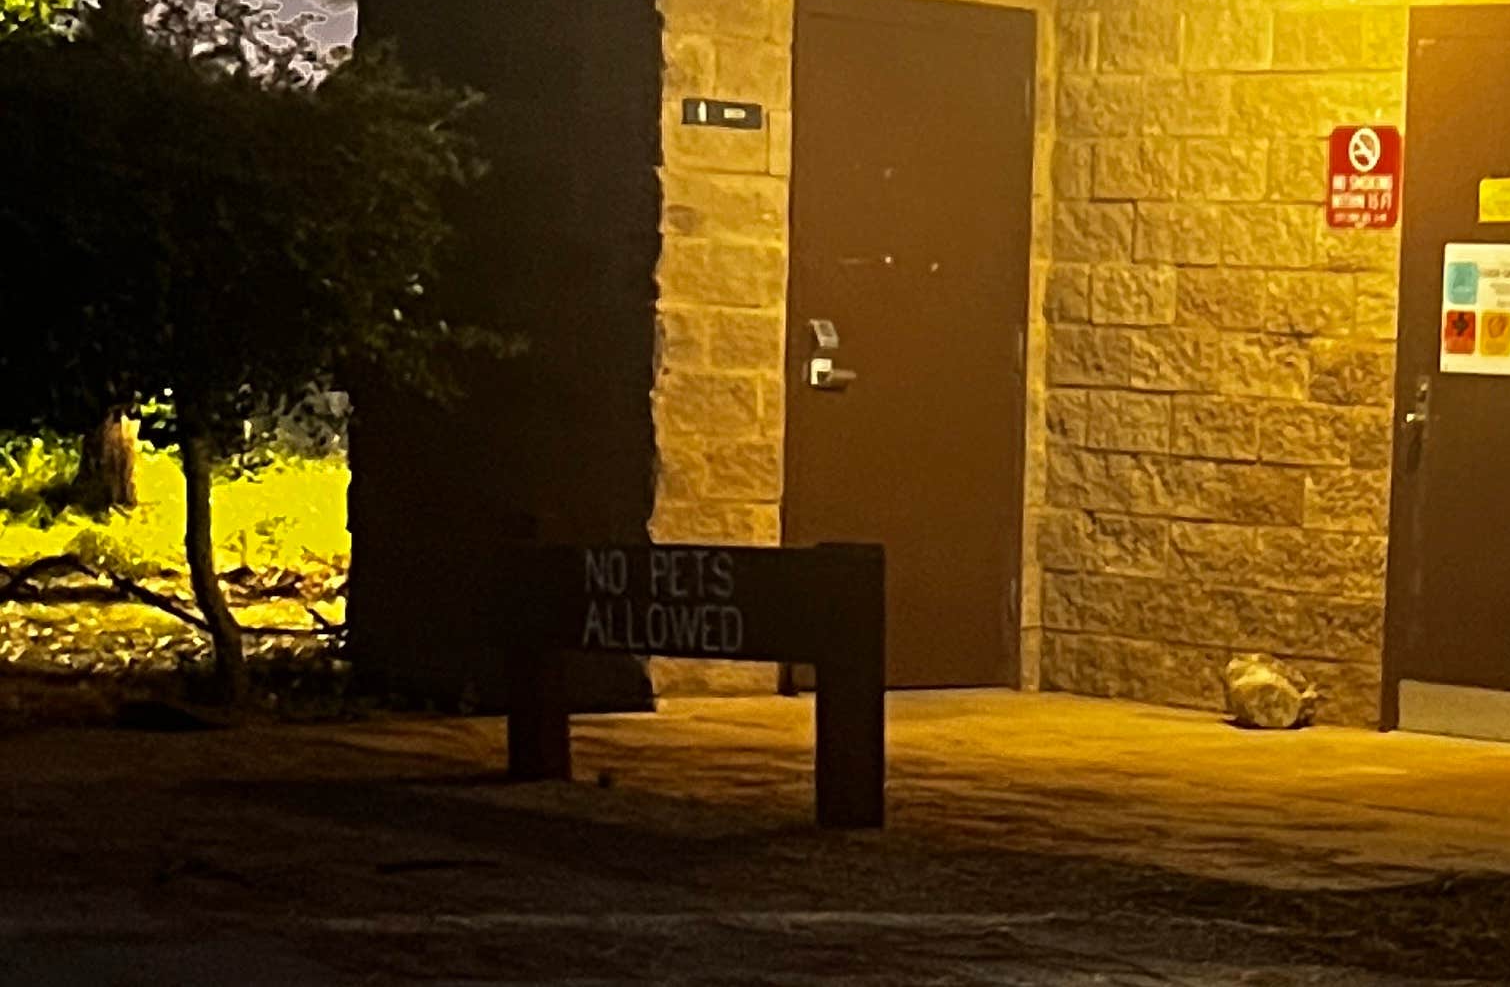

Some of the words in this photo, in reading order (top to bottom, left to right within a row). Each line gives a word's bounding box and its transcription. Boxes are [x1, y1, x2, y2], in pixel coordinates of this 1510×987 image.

[585, 548, 627, 595] NO
[650, 550, 735, 598] PETS
[581, 600, 743, 652] ALLOWED
